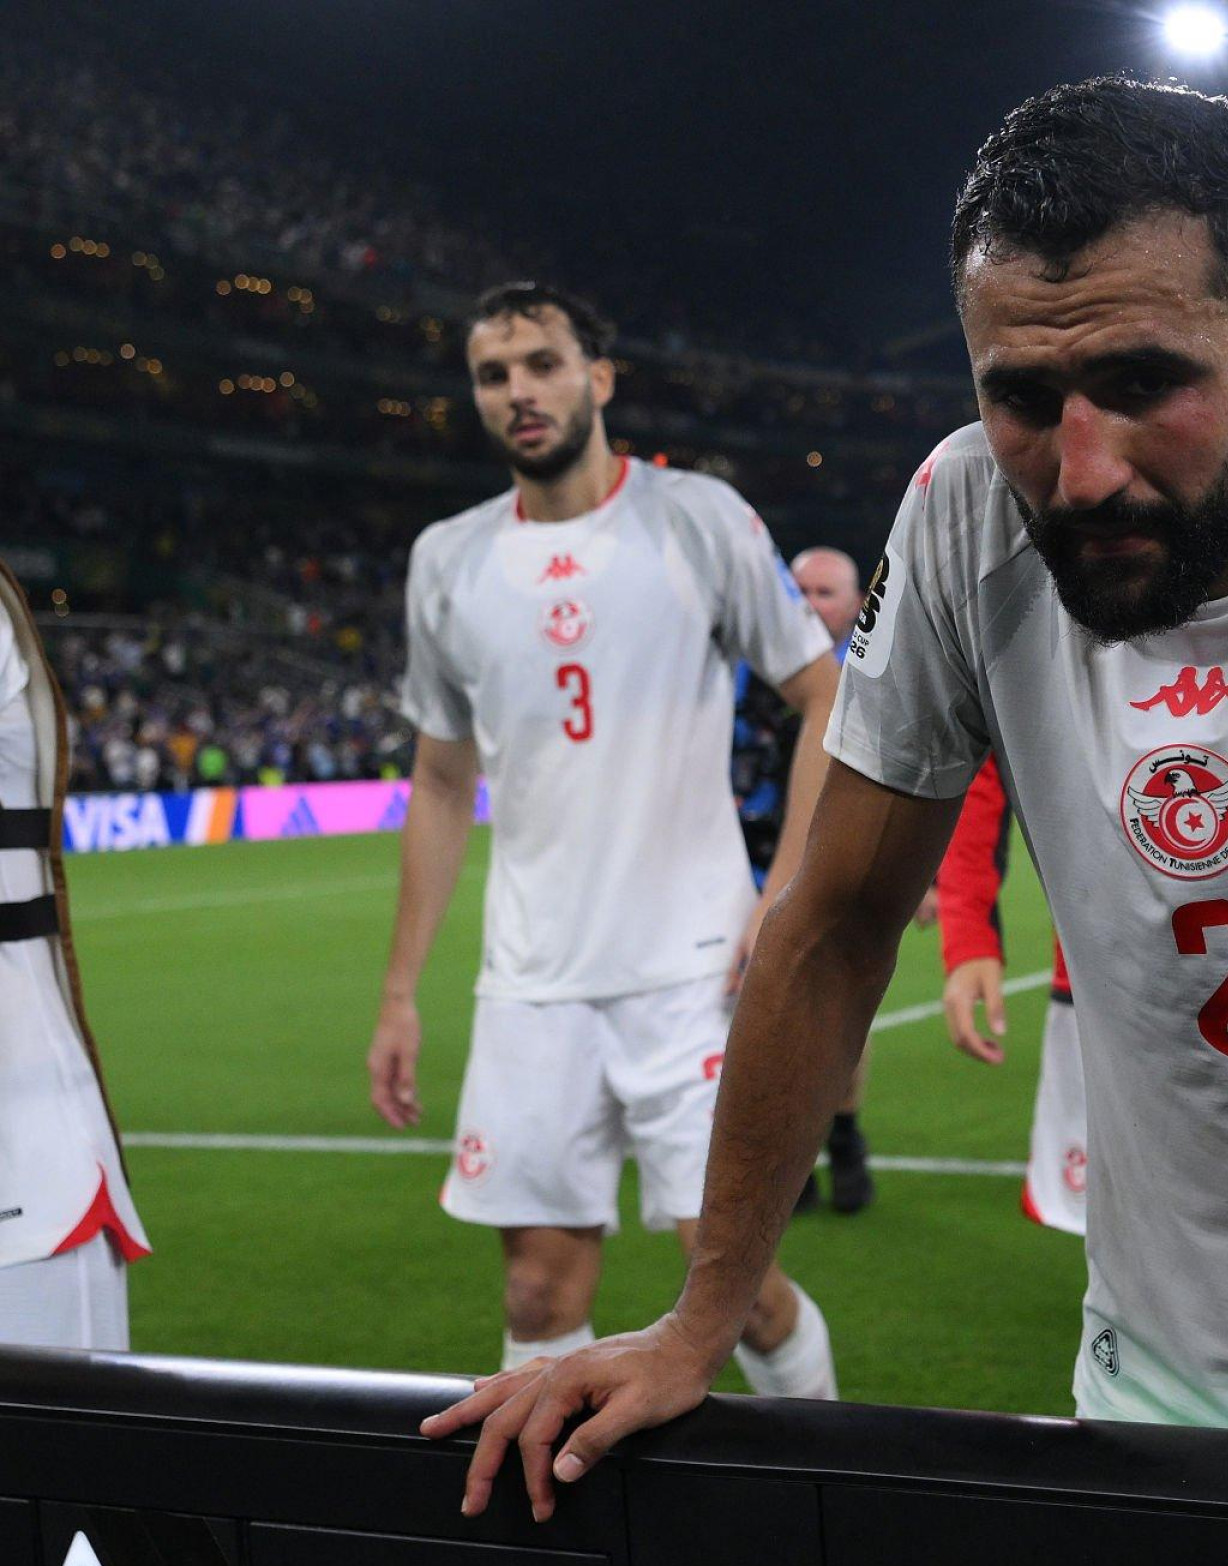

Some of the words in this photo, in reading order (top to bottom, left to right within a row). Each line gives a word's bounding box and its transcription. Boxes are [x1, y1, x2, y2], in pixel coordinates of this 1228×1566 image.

[850, 640, 866, 659] 26
[556, 664, 592, 742] 3
[64, 793, 170, 853] VISA
